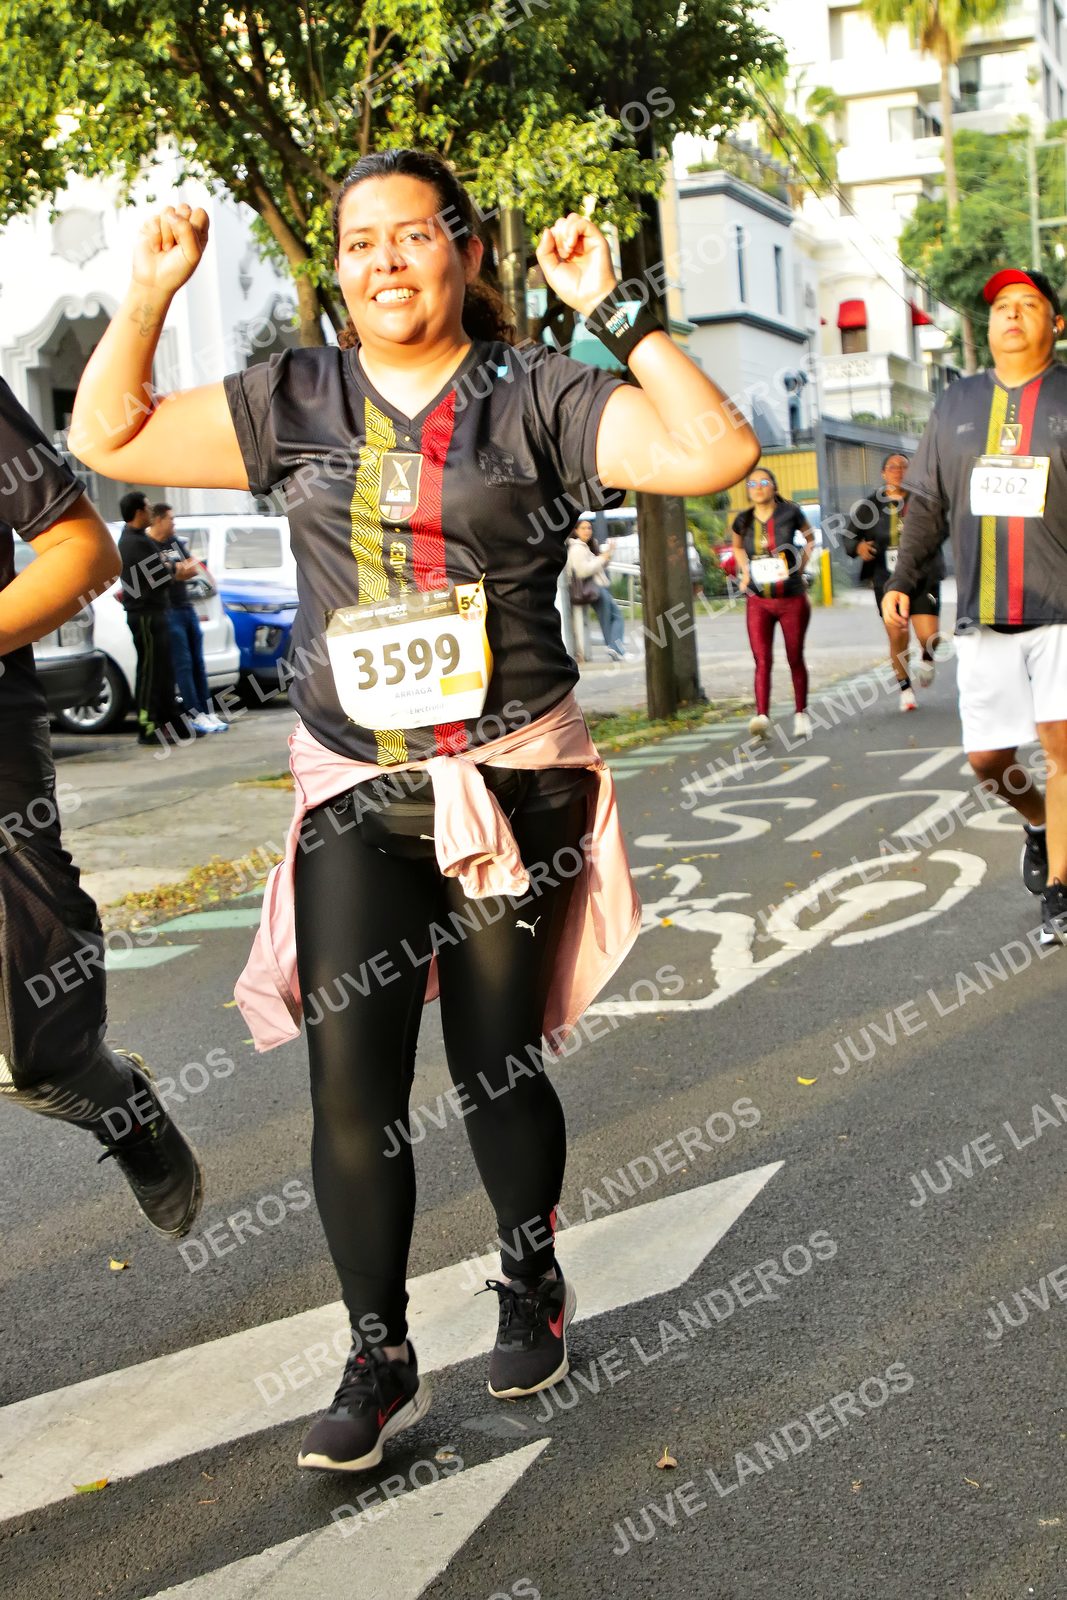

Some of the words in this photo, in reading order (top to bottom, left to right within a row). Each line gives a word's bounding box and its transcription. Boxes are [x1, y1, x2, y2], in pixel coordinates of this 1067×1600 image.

[980, 476, 1028, 496] 4262
[352, 632, 461, 691] 3599
[394, 686, 434, 700] ARRIAGA
